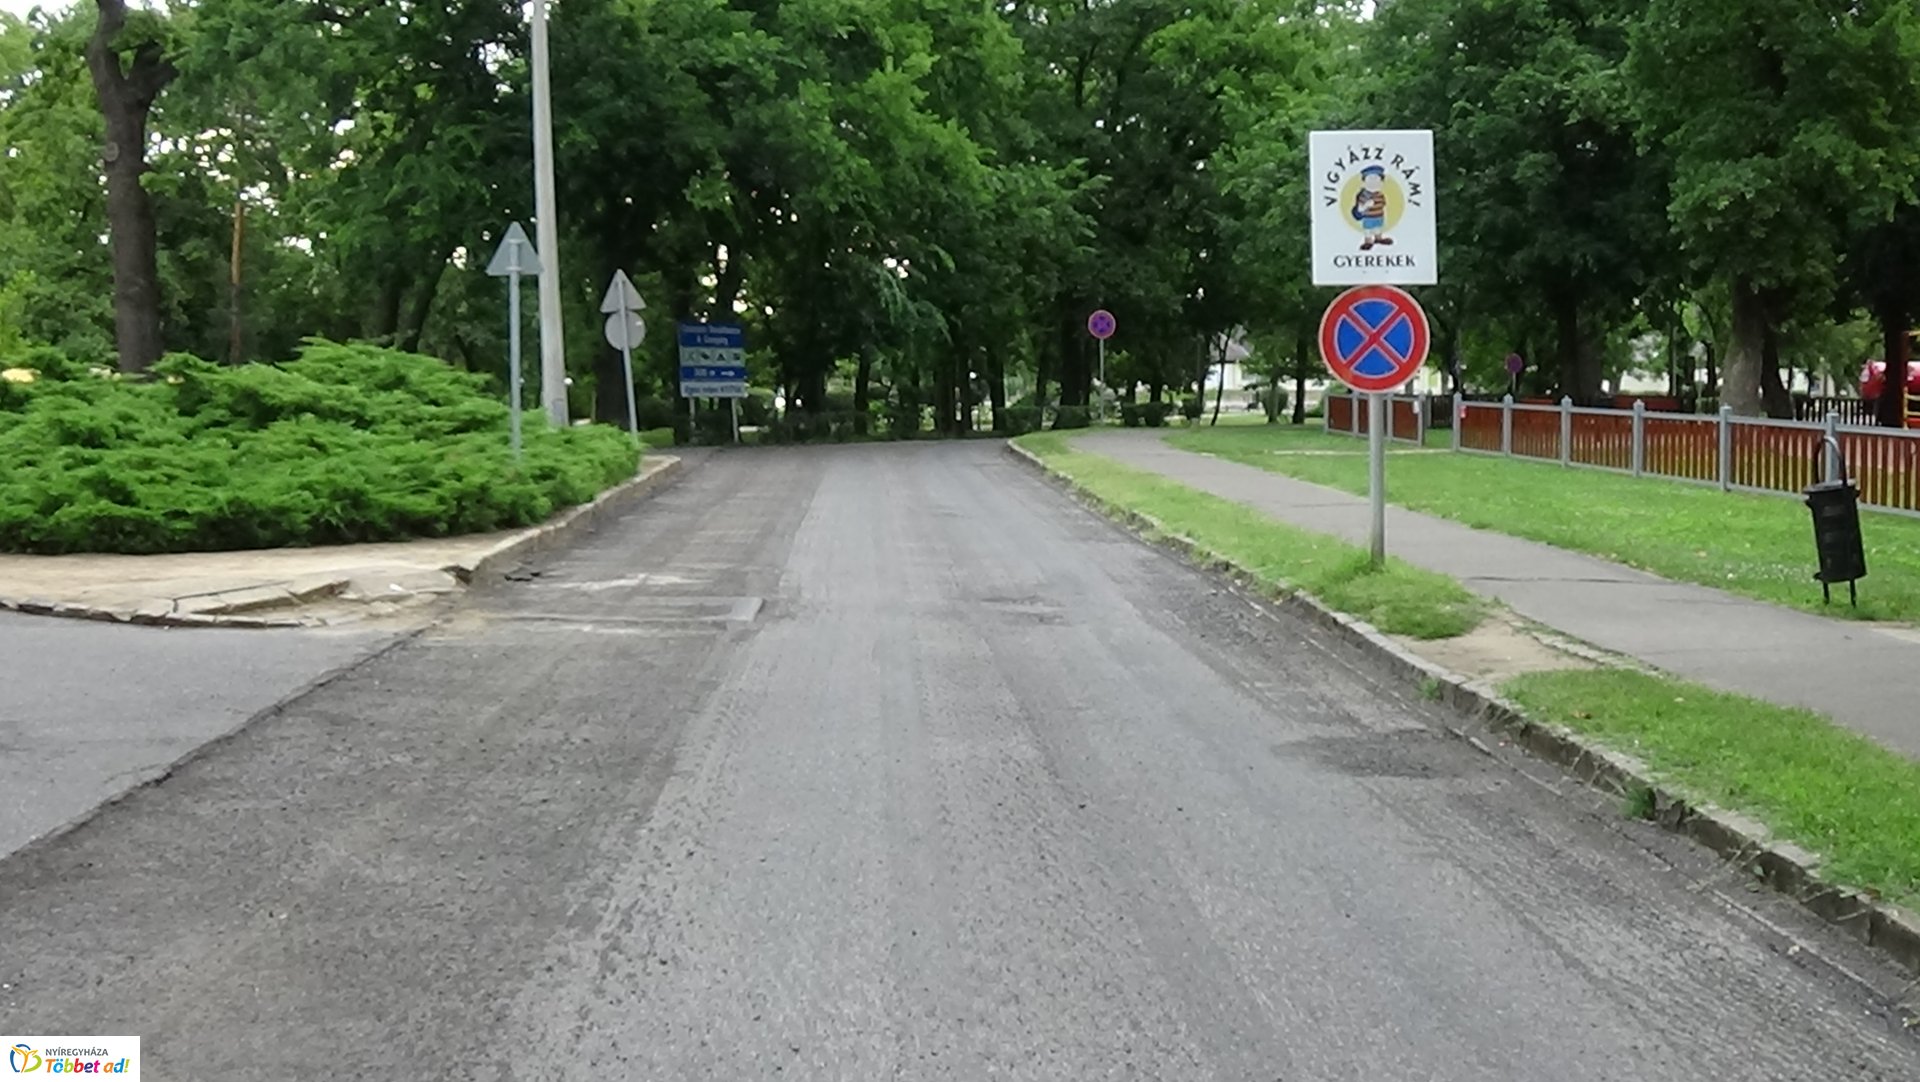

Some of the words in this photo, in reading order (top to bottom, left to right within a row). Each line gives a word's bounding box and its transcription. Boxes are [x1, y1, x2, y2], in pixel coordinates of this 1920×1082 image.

[1323, 145, 1384, 207] VIGYÁZZ
[1391, 153, 1422, 208] RÁM!
[1333, 255, 1415, 268] GYEREKEK
